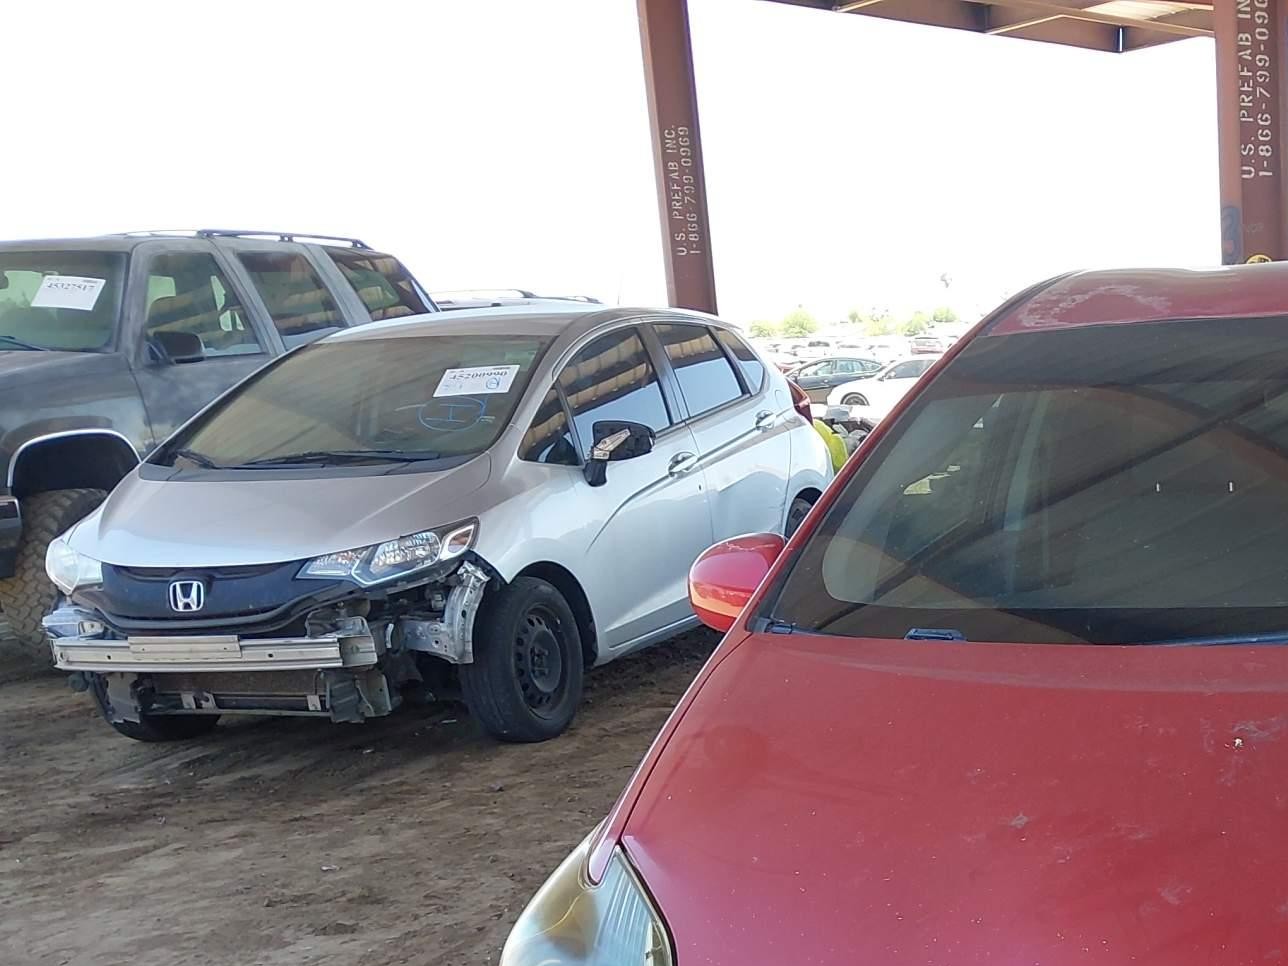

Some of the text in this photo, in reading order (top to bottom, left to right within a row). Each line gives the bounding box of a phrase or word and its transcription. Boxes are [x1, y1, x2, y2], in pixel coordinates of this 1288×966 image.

[1237, 33, 1254, 121] PREFAB
[664, 125, 688, 256] U.S. PREFAB INC.
[678, 126, 701, 254] 1-866-799-0969
[1241, 137, 1255, 179] U.S.
